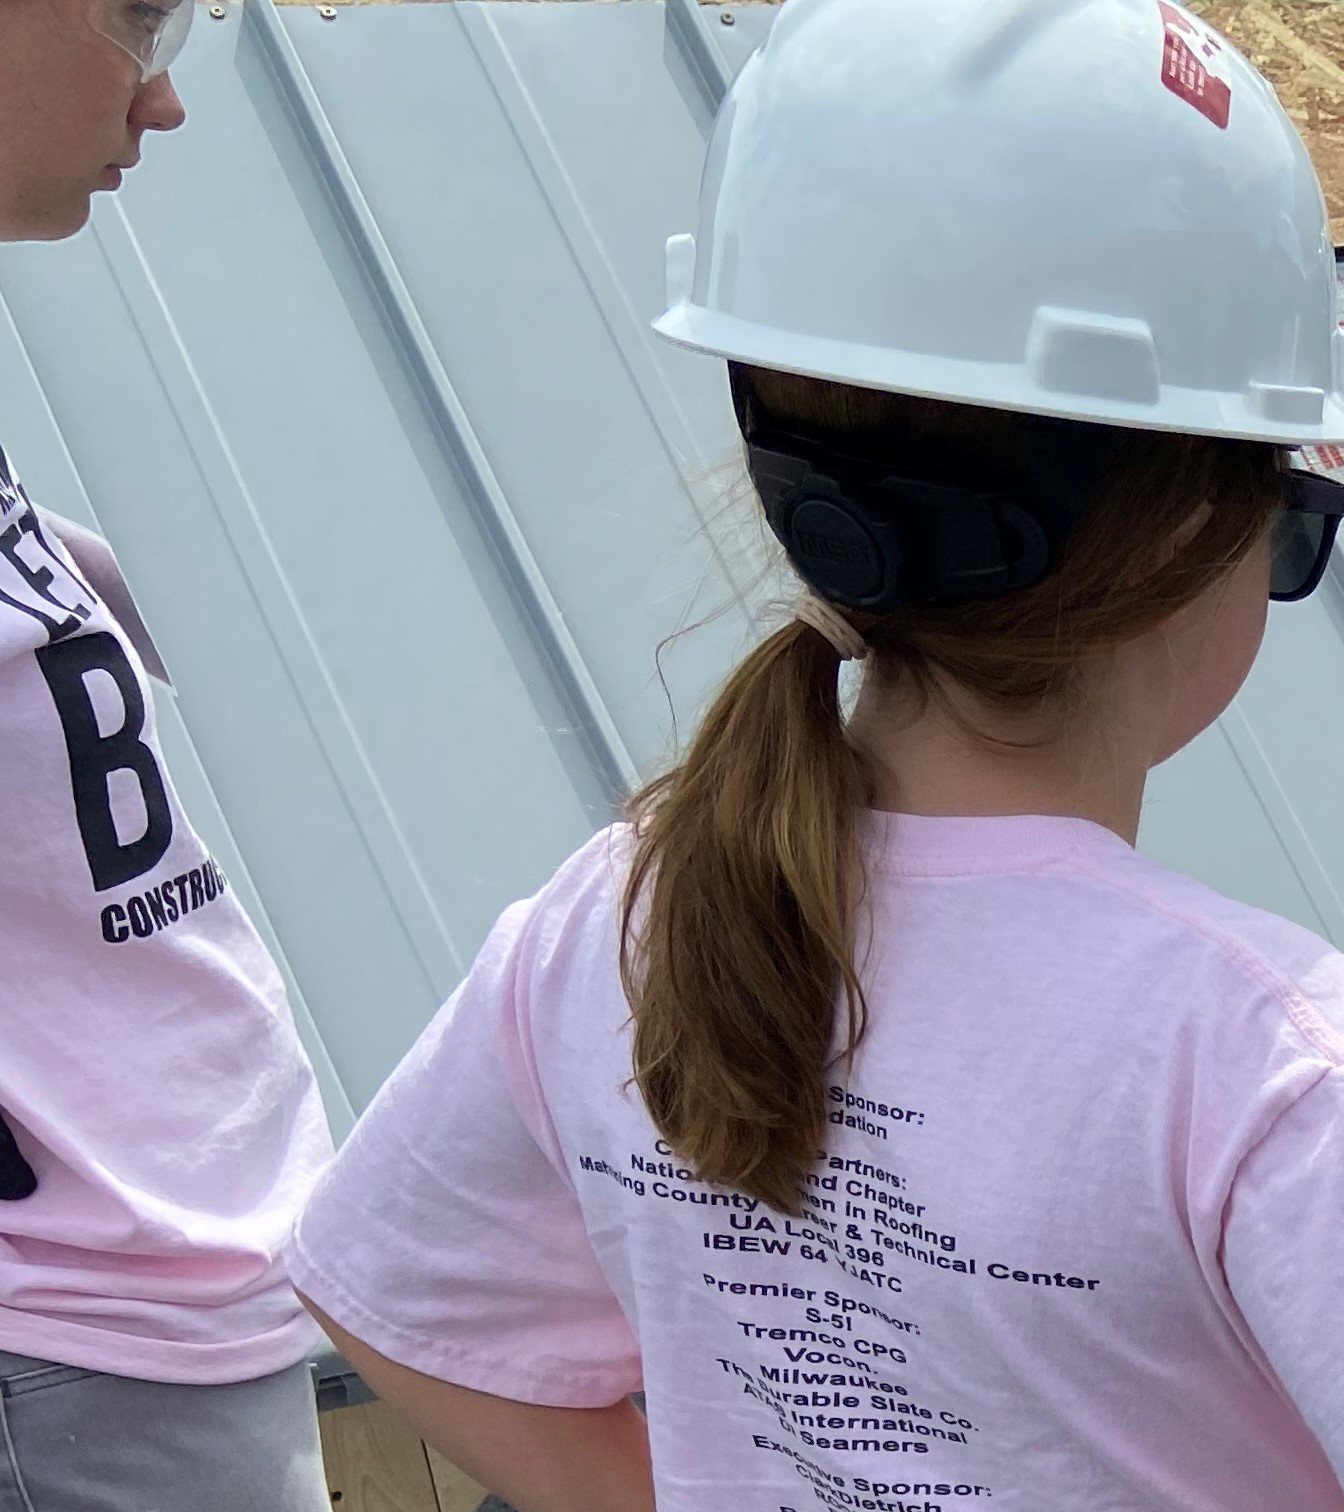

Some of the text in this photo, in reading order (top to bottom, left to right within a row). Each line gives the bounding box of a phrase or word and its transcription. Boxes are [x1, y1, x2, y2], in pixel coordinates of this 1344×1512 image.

[830, 1085, 925, 1125] Sponsor:
[829, 1109, 888, 1140] dation
[631, 1153, 701, 1182] Natio
[845, 1200, 866, 1221] in
[874, 1208, 956, 1251] Roofing
[846, 1180, 926, 1218] Chapter
[652, 1182, 760, 1211] County
[800, 1210, 838, 1234] reer
[845, 1224, 863, 1242] &
[870, 1229, 976, 1275] Technical
[987, 1262, 1100, 1291] Center
[703, 1232, 791, 1255] IBEW
[800, 1245, 828, 1264] 64
[729, 1213, 885, 1267] UA Local 396
[702, 1273, 922, 1336] Premier Sponsor:
[737, 1321, 907, 1364] Tremco CPG
[783, 1346, 879, 1375] Vocon.
[715, 1358, 980, 1432] The Durable Slate Co.
[759, 1364, 908, 1396] Milwaukee
[791, 1410, 968, 1446] International
[799, 1430, 930, 1454] Seamers
[853, 1478, 992, 1497] Sponsor:
